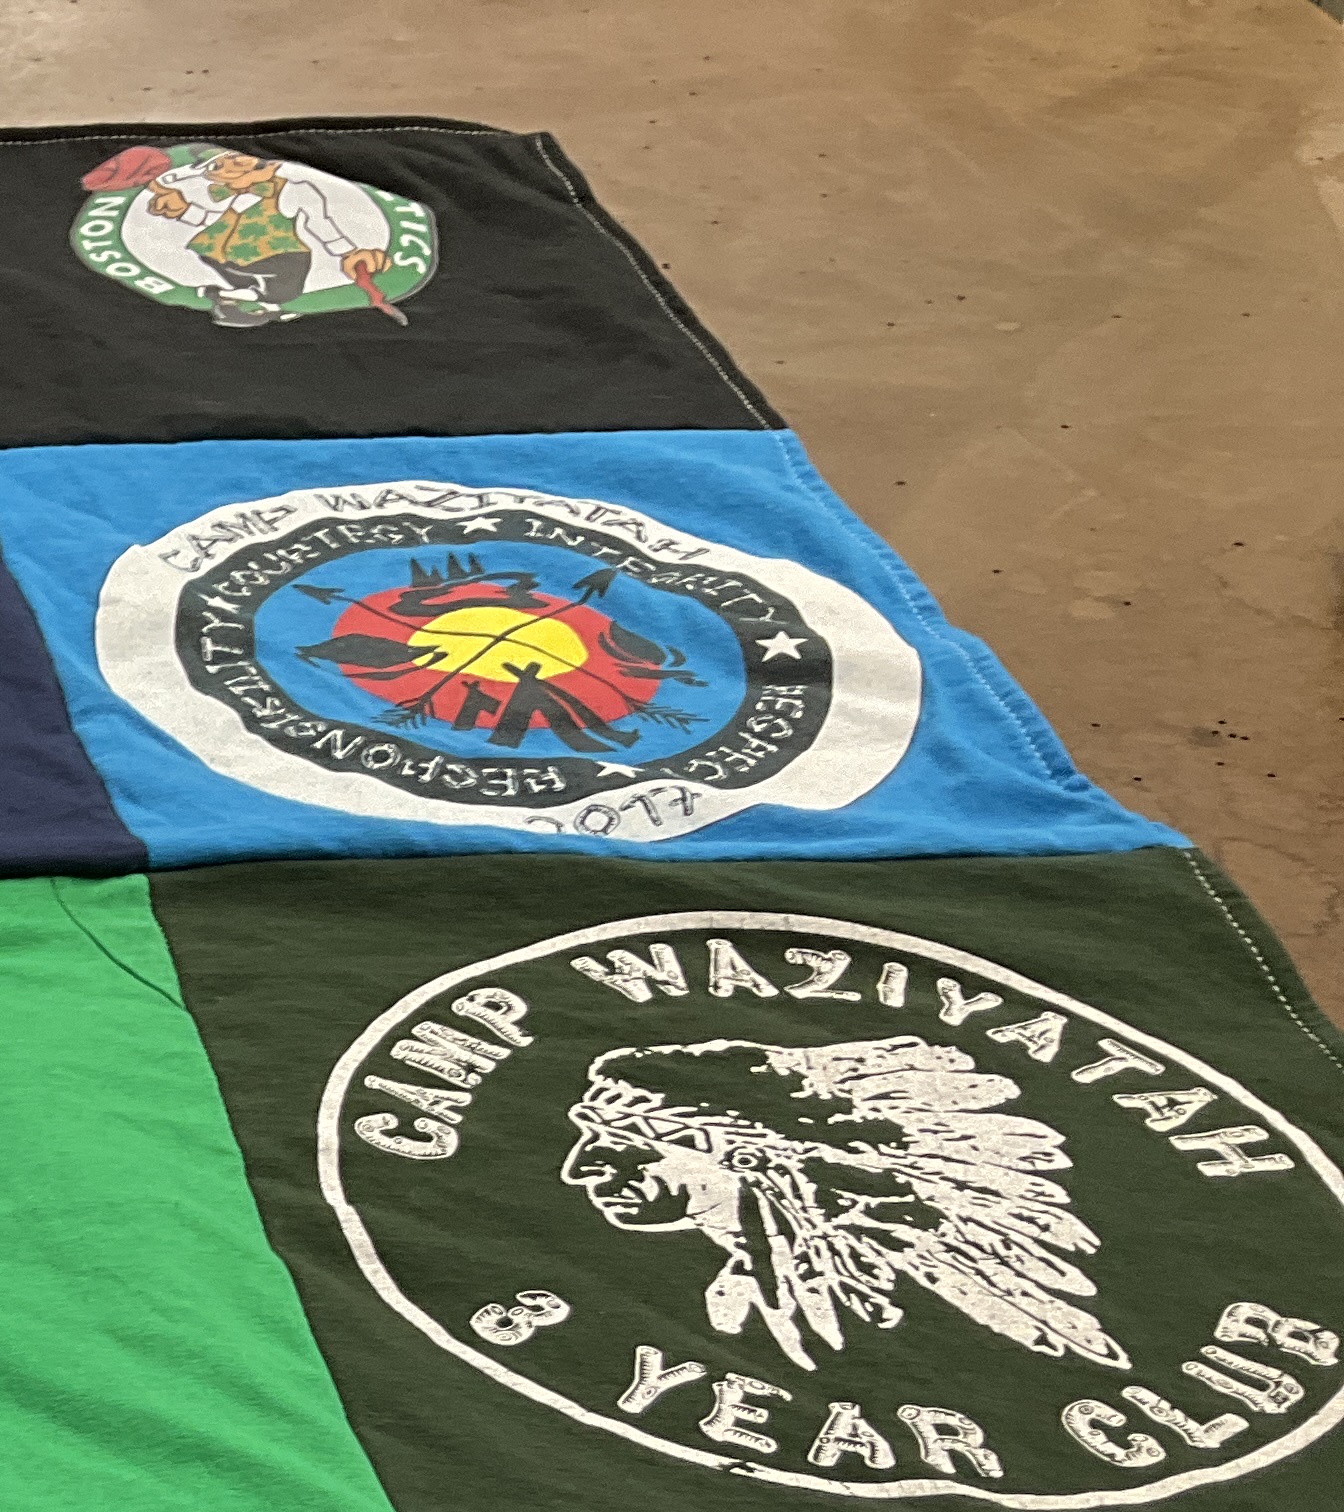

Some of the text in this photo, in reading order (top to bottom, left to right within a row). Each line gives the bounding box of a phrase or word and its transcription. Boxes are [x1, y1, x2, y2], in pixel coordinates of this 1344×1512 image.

[79, 196, 176, 294] BOSTON
[158, 504, 297, 573] CAMP
[353, 939, 1295, 1180] CAMP WAZIYATAH
[617, 1345, 1004, 1478] YEAR
[1061, 1302, 1341, 1469] CLUB
